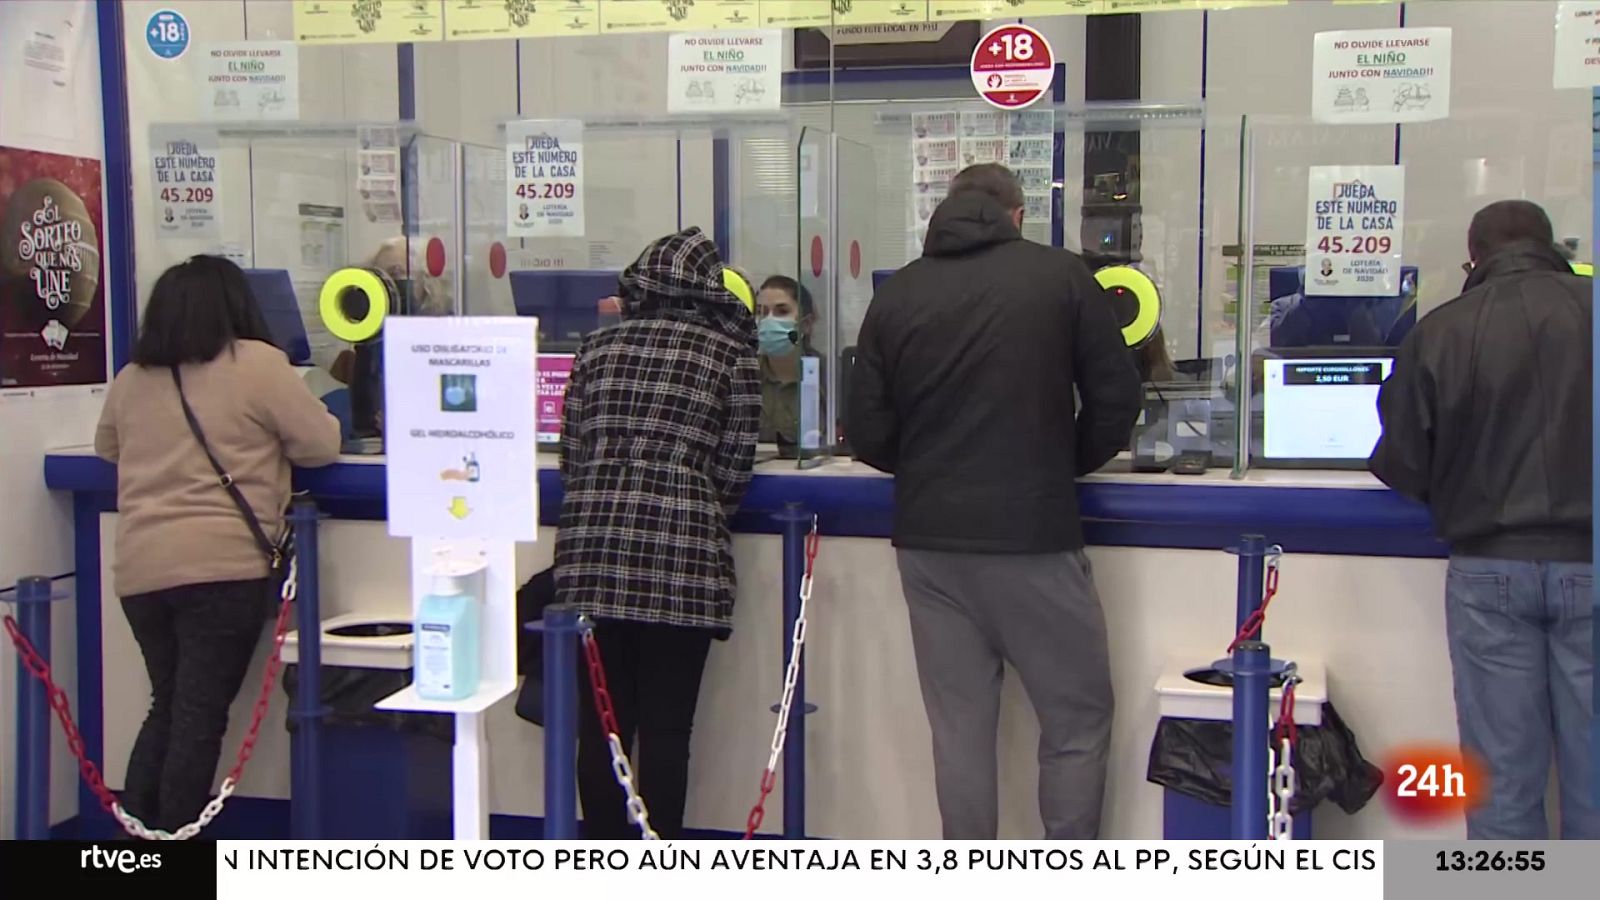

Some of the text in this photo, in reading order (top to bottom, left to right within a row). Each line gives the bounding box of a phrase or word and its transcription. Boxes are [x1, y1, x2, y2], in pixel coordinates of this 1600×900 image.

[150, 22, 180, 42] +18
[883, 24, 906, 32] LOCAL
[909, 23, 919, 31] EN
[988, 33, 1034, 60] +18
[1334, 38, 1430, 49] NO OLVIDE LLEVARSE
[703, 48, 745, 61] EL NIÑO
[1357, 51, 1406, 64] EL NIÑO
[228, 59, 265, 71] EL NIÑO
[1328, 67, 1433, 78] JUNTO CON NAVIDAD!!
[155, 157, 176, 169] ESTE
[512, 151, 535, 163] ESTE
[157, 170, 214, 182] DE LA CASA
[514, 165, 576, 178] DE LA CASA
[160, 187, 214, 203] 45.209
[516, 183, 575, 199] 45.209
[33, 196, 62, 226] EL
[1315, 200, 1344, 214] ESTE
[1317, 216, 1394, 230] DE LA CASA
[19, 220, 83, 260] SORTEO
[1317, 236, 1391, 254] 45.209
[35, 243, 82, 272] QUE NOS
[30, 266, 71, 310] UNE
[411, 344, 431, 353] USO
[433, 344, 493, 353] OBLIGATORIO
[428, 358, 491, 367] MASCARILLAS
[1333, 374, 1349, 382] EUR
[410, 429, 427, 438] GEL
